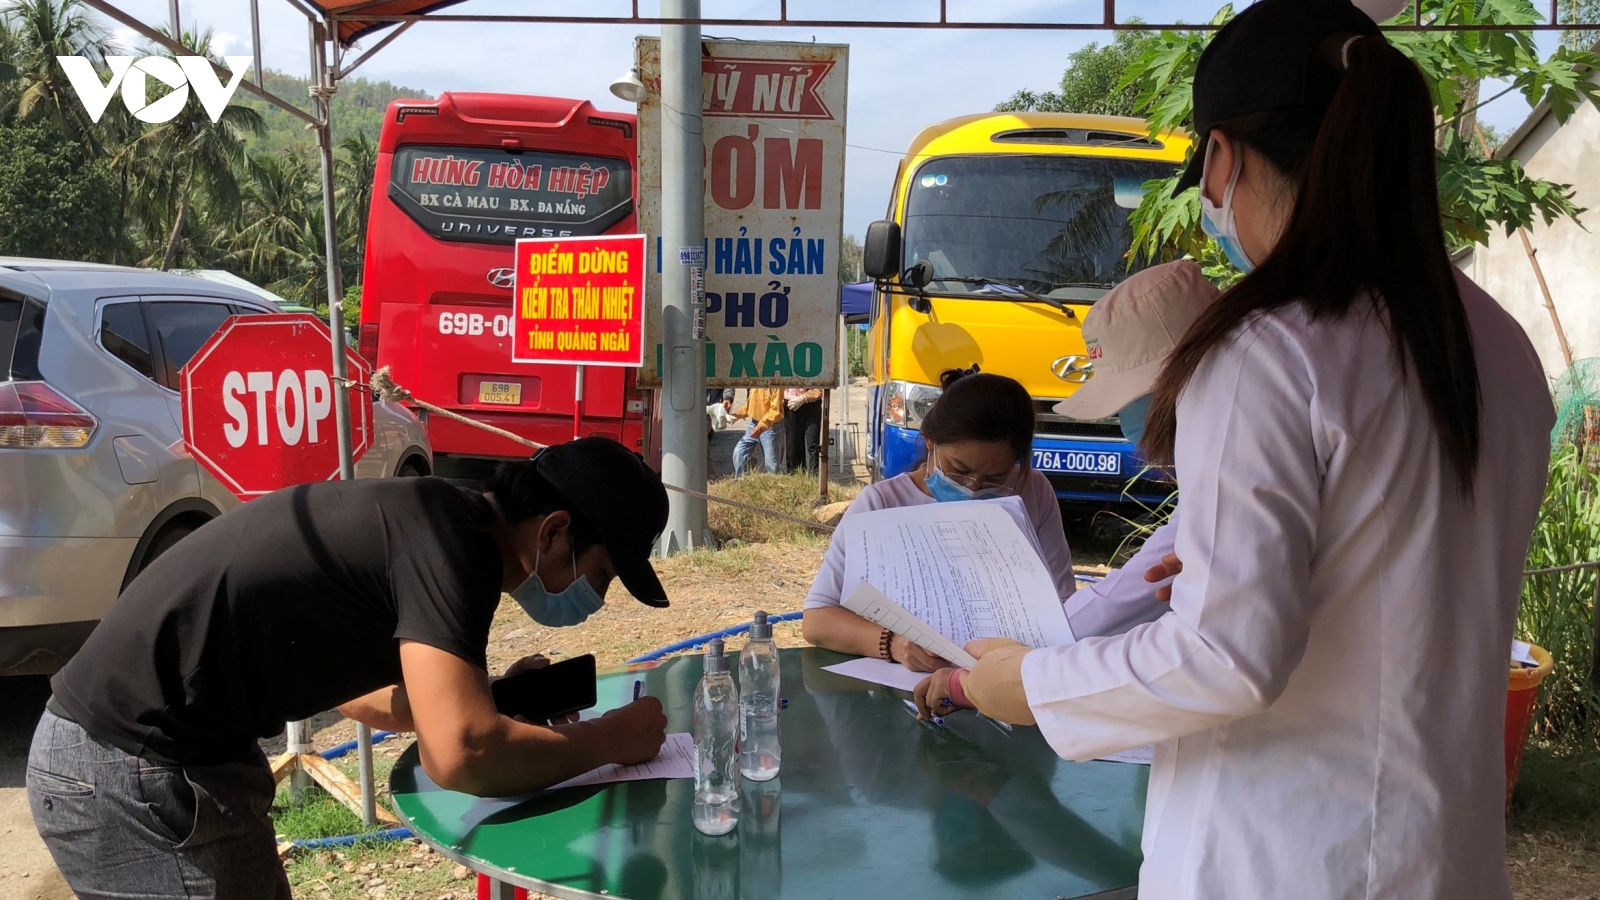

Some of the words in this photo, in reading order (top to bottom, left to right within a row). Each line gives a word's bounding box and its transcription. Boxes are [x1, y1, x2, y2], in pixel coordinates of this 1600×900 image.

[752, 66, 813, 112] NỮ
[411, 155, 485, 186] HƯNG
[487, 158, 542, 191] HÒA
[548, 162, 610, 200] HIỆP
[702, 124, 824, 210] ƠM
[420, 194, 440, 206] BX
[443, 192, 462, 208] CÀ
[466, 196, 500, 209] MAU
[538, 202, 553, 213] ĐA
[530, 243, 574, 275] ĐIỂM
[578, 246, 628, 274] DỪNG
[715, 226, 762, 275] HẢI
[769, 226, 825, 275] SẢN
[522, 275, 547, 319] KIỂM
[550, 287, 569, 319] TRA
[572, 280, 600, 319] THÂN
[602, 279, 634, 326] NHIỆT
[528, 324, 554, 349] TỈNH
[557, 324, 597, 352] QUẢNG
[600, 328, 630, 351] NGÃI
[729, 334, 823, 378] XÀO
[484, 392, 516, 403] 005.41
[492, 383, 510, 393] 69B
[222, 368, 332, 448] STOP
[1033, 451, 1117, 471] 76A-000.98
